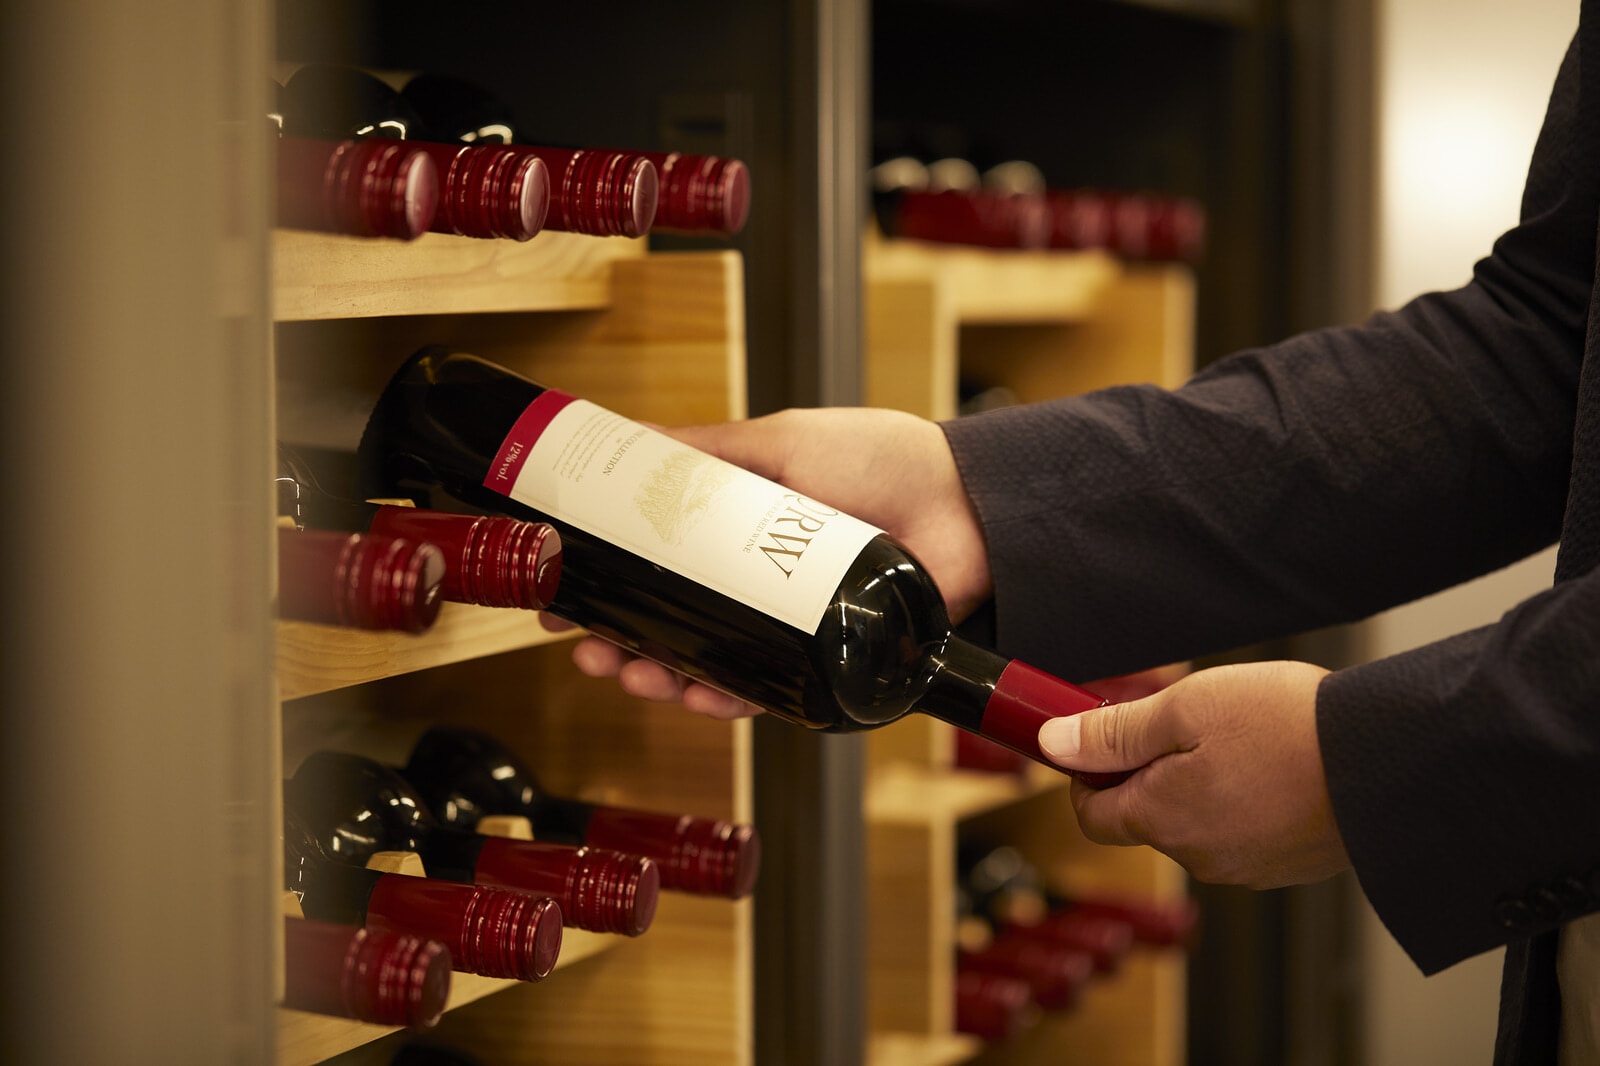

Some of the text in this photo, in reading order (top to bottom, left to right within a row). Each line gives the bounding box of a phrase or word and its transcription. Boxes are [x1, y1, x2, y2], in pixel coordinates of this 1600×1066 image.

[603, 434, 638, 476] COLLECTION
[743, 516, 770, 554] RED WINE
